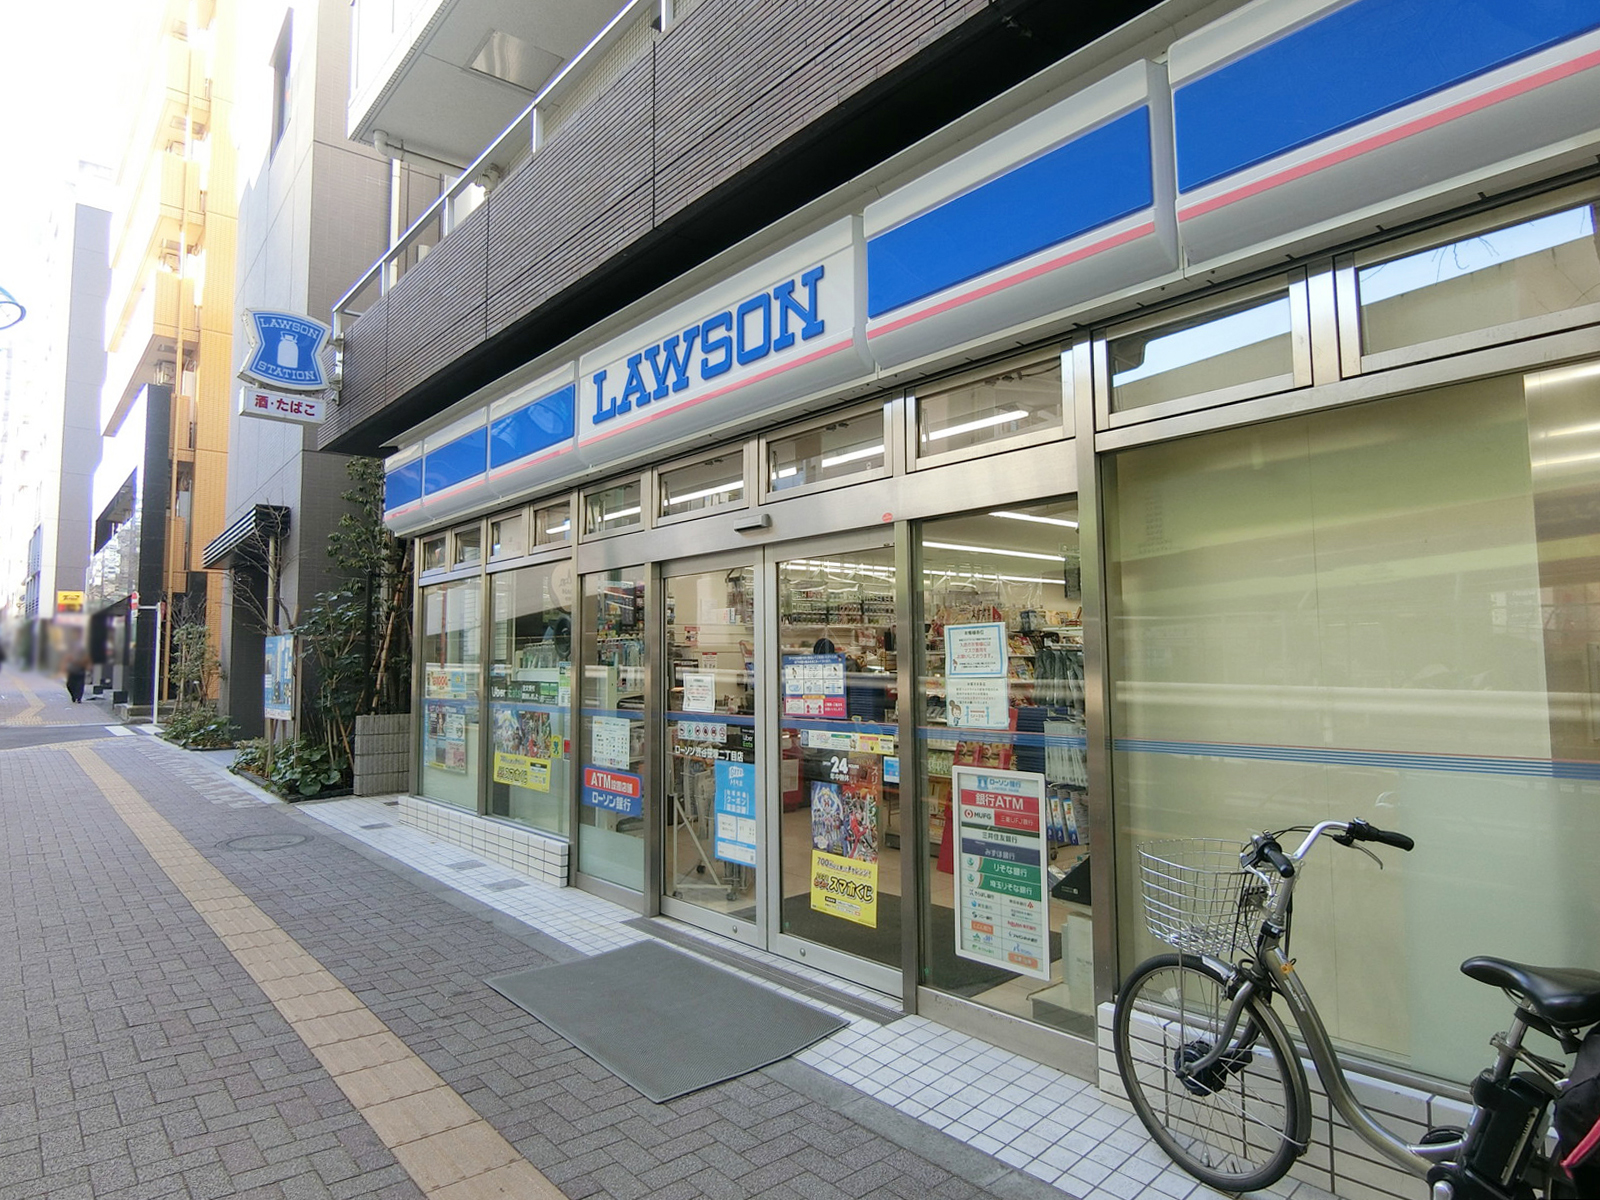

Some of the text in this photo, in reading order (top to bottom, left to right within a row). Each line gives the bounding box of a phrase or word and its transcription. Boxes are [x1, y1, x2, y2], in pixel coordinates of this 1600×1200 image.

[259, 318, 319, 340] LAWSON
[592, 265, 825, 425] LAWSON
[256, 360, 316, 380] STATION
[254, 394, 316, 417] 酒・たばこ
[491, 686, 506, 698] Uber
[742, 734, 754, 742] Uber
[830, 755, 849, 774] 24
[989, 778, 1022, 788] ローソン銀行
[592, 791, 632, 812] ローソン銀行
[975, 793, 1024, 811] 銀行ATM
[974, 811, 992, 820] MUFG
[982, 831, 1018, 844] 三井住友銀行
[984, 848, 1016, 860] みずほ銀行
[993, 863, 1028, 878] りそな銀行
[828, 875, 875, 904] スマホくじ
[989, 880, 1033, 896] 埼玉りそな銀行
